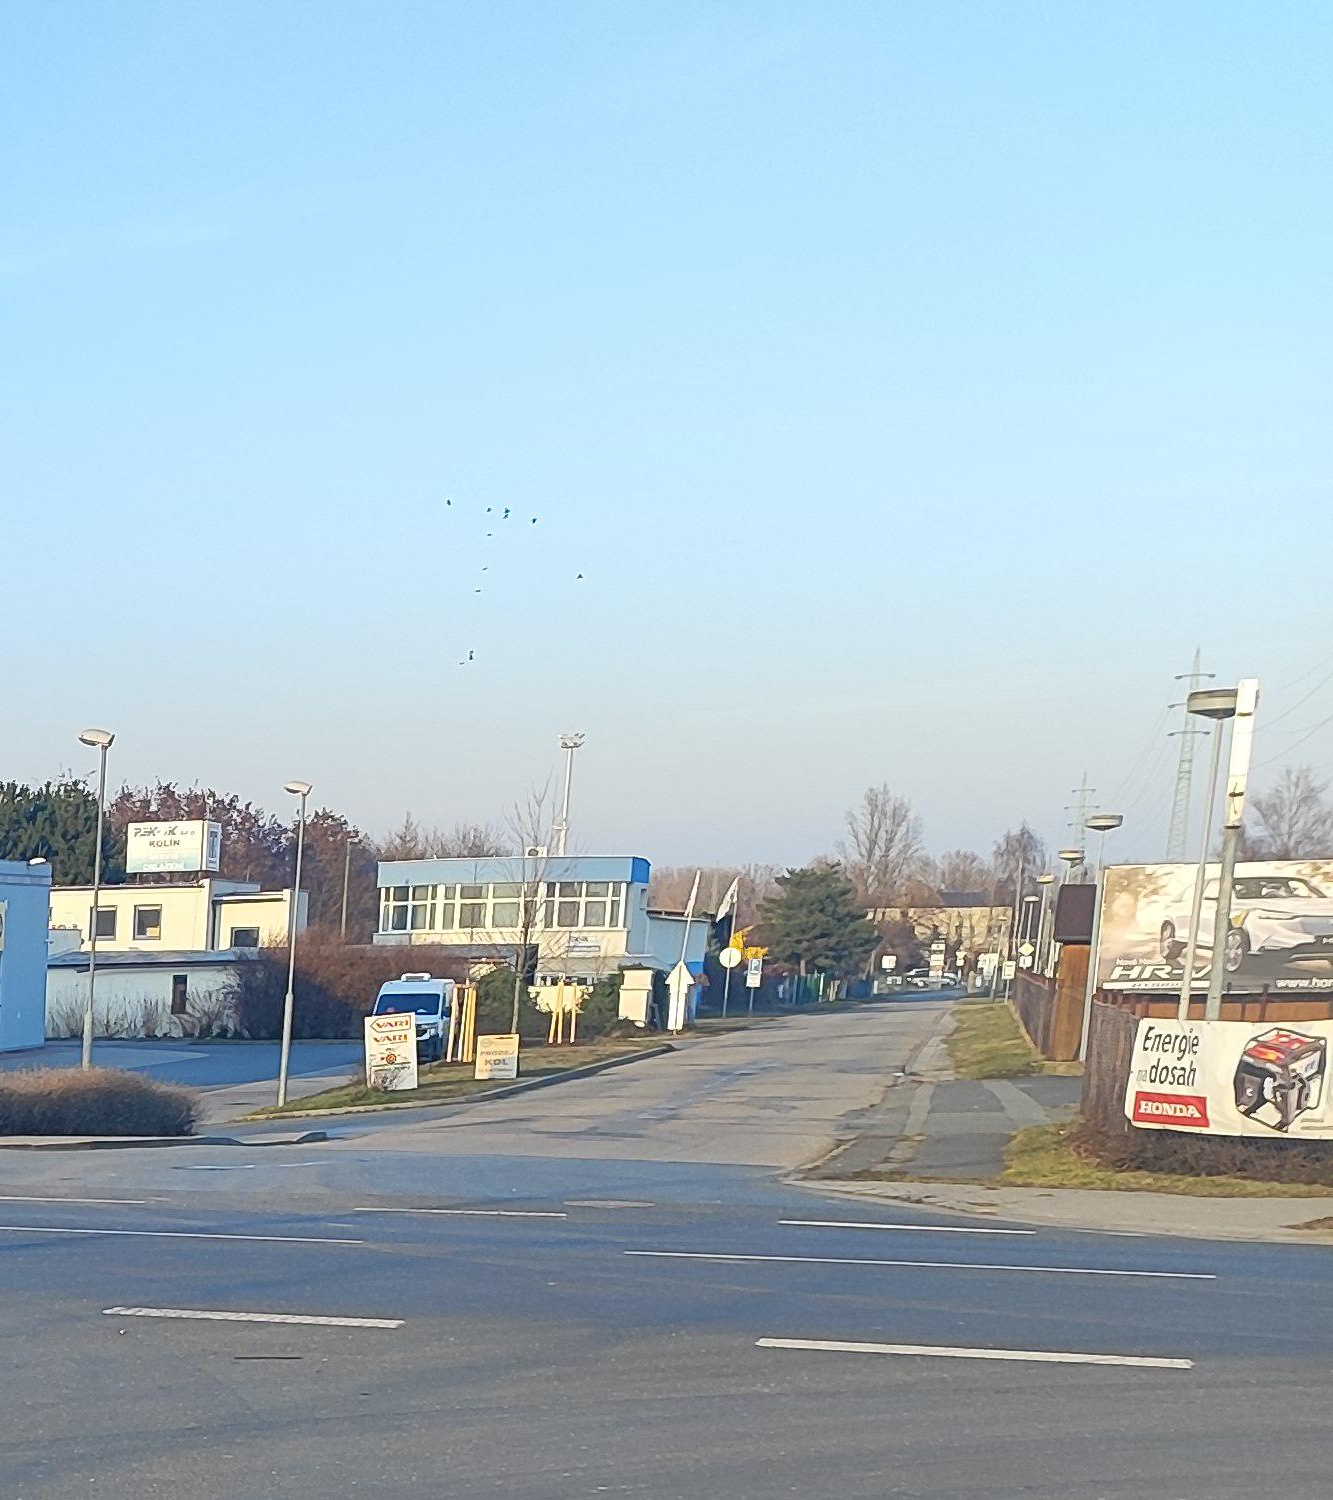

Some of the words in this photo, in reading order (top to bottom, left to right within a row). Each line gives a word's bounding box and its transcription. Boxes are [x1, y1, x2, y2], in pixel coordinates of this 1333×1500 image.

[375, 1019, 409, 1030] VARI
[373, 1034, 408, 1043] VARI
[1142, 1025, 1200, 1061] Energie
[1149, 1058, 1197, 1087] dosah
[1138, 1100, 1202, 1118] HONDA
